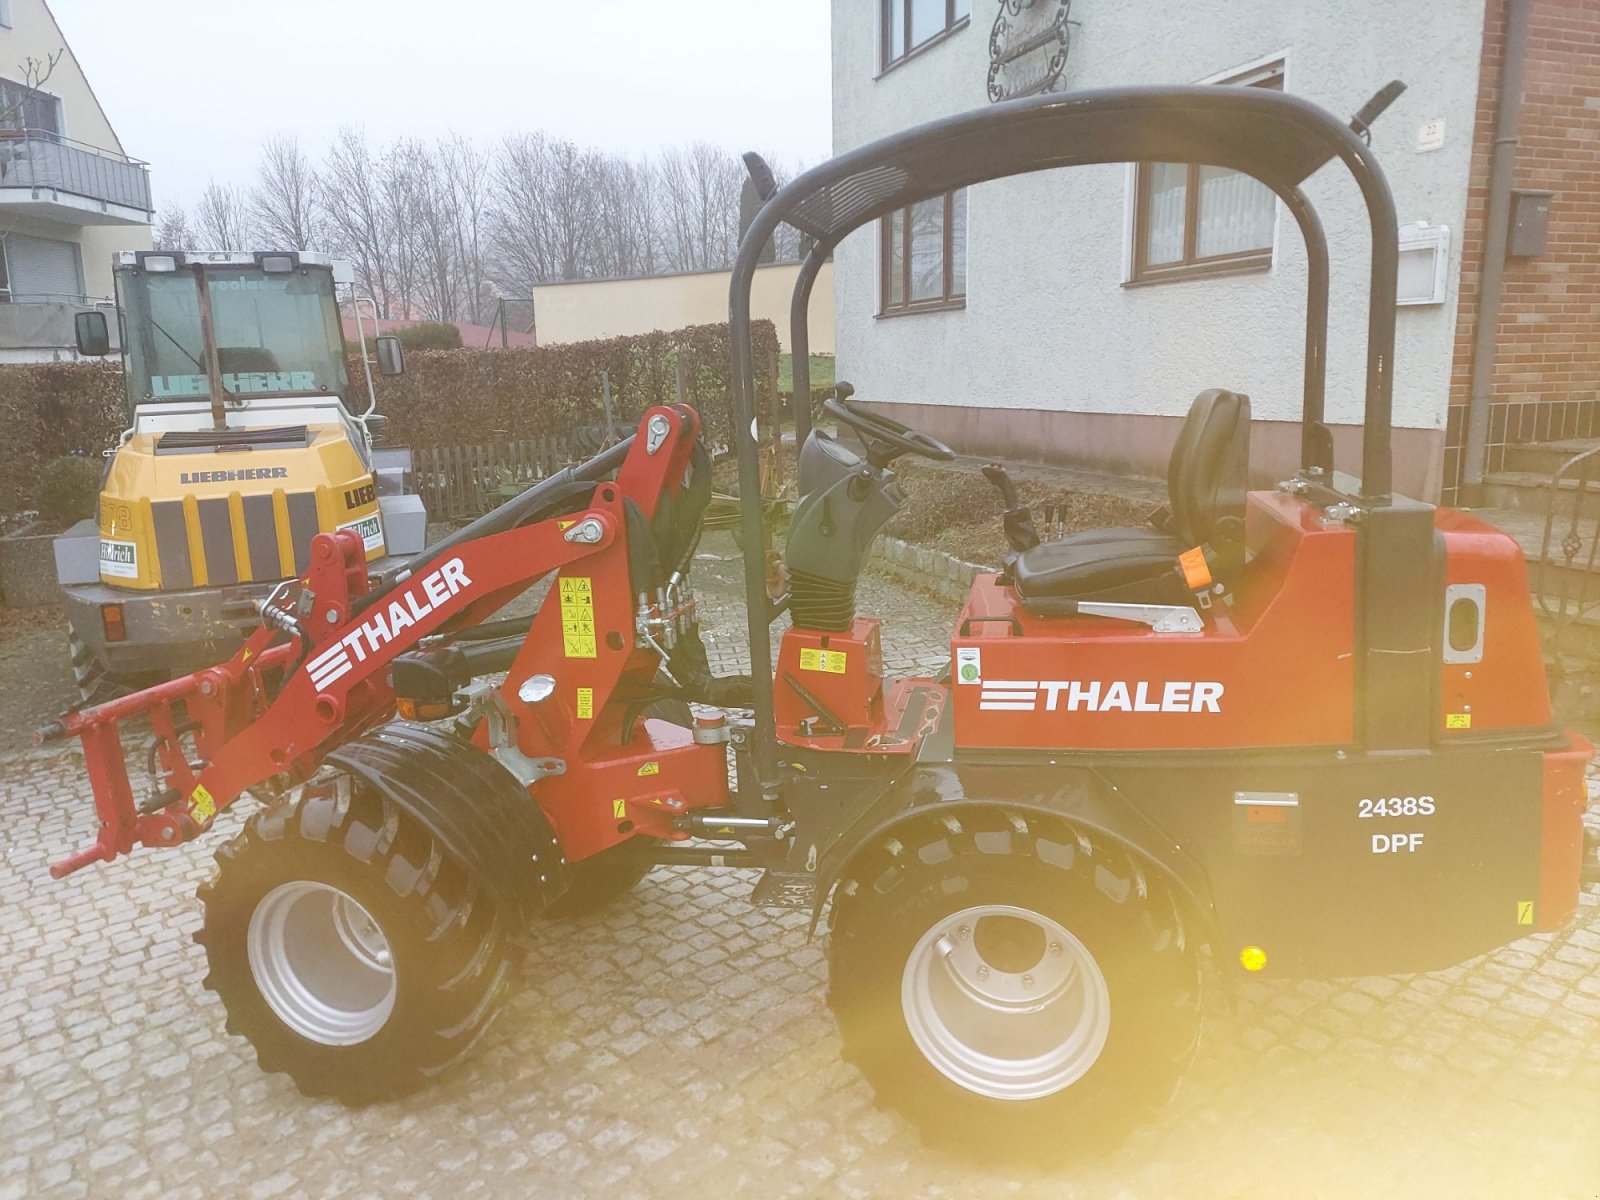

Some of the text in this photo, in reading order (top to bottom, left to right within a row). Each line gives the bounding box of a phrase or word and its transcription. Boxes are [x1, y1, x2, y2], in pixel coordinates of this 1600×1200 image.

[180, 467, 288, 484] LIEBHERR
[344, 557, 472, 662] THALER
[1039, 681, 1225, 713] THALER
[1358, 796, 1436, 818] 2438S
[1372, 833, 1424, 853] DPF
